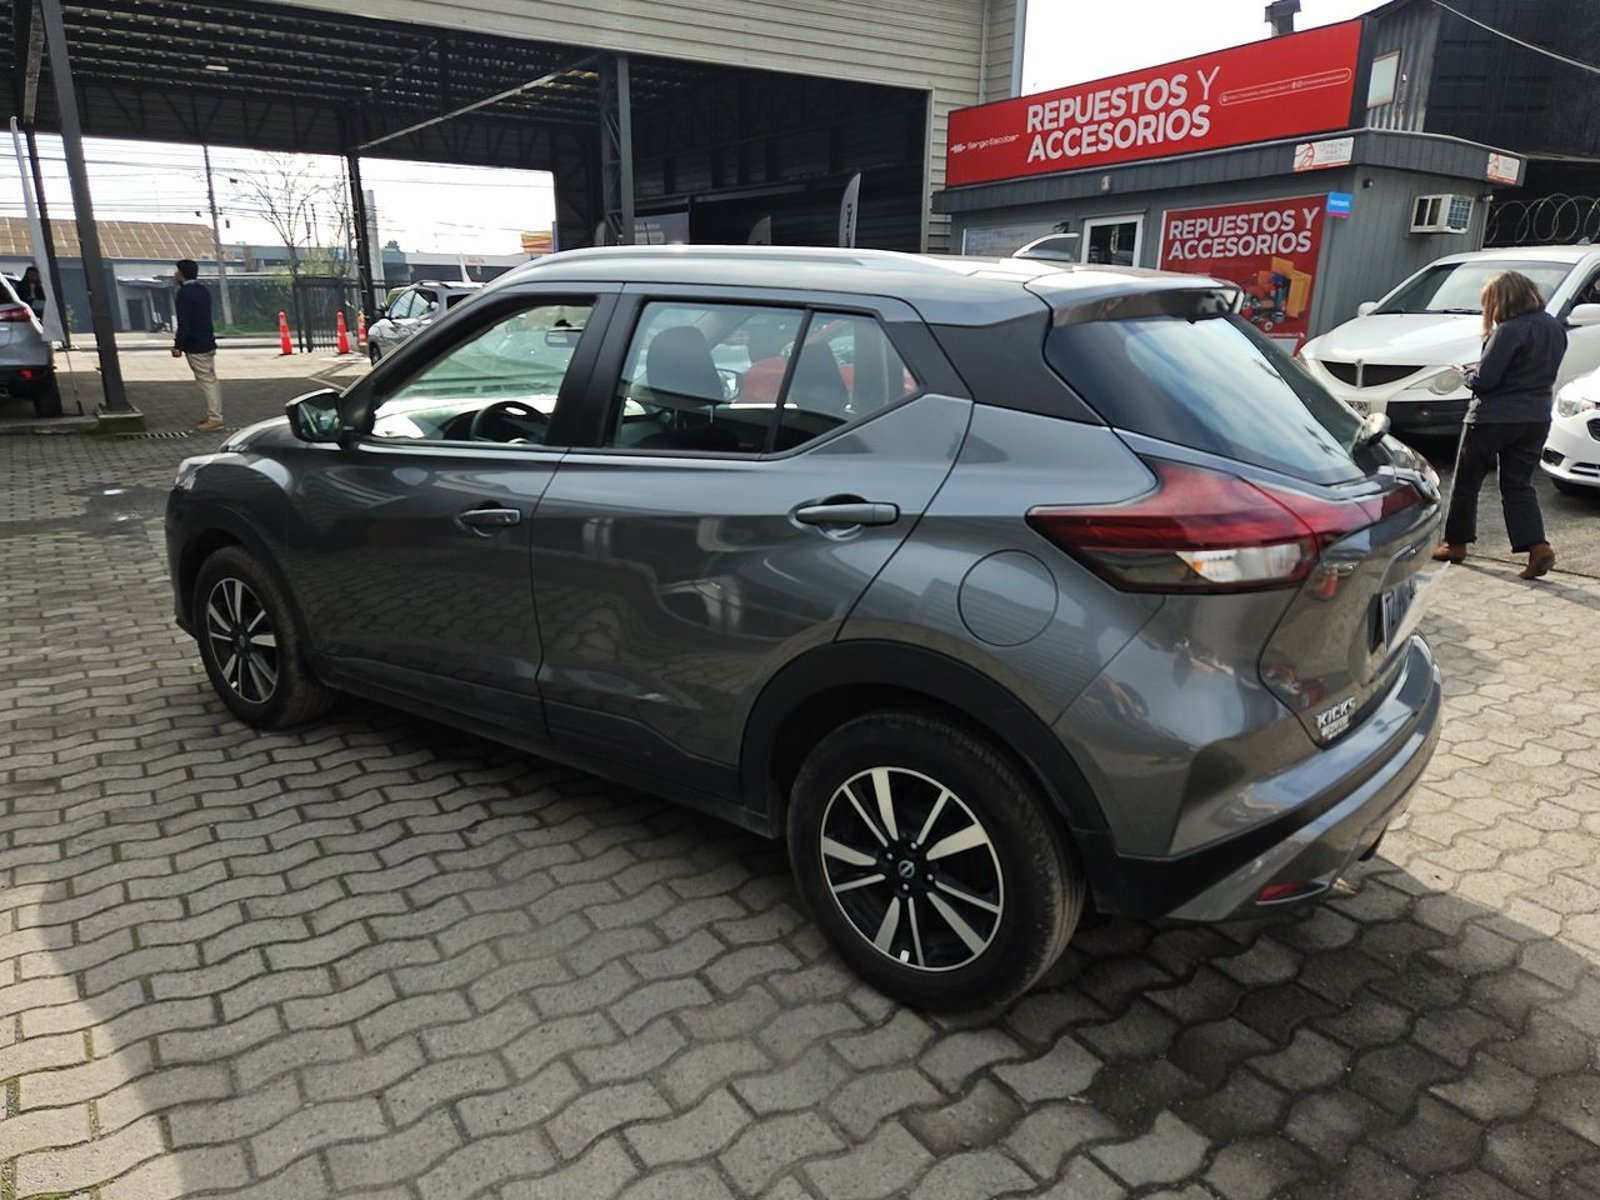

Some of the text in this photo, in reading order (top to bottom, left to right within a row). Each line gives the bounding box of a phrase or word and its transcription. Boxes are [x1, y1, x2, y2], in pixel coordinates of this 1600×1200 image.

[1026, 66, 1220, 133] REPUESTOS Y
[1026, 104, 1211, 163] ACCESORIOS
[1168, 206, 1320, 240] REPUESTOS Y
[1168, 230, 1313, 261] ACCESORIOS
